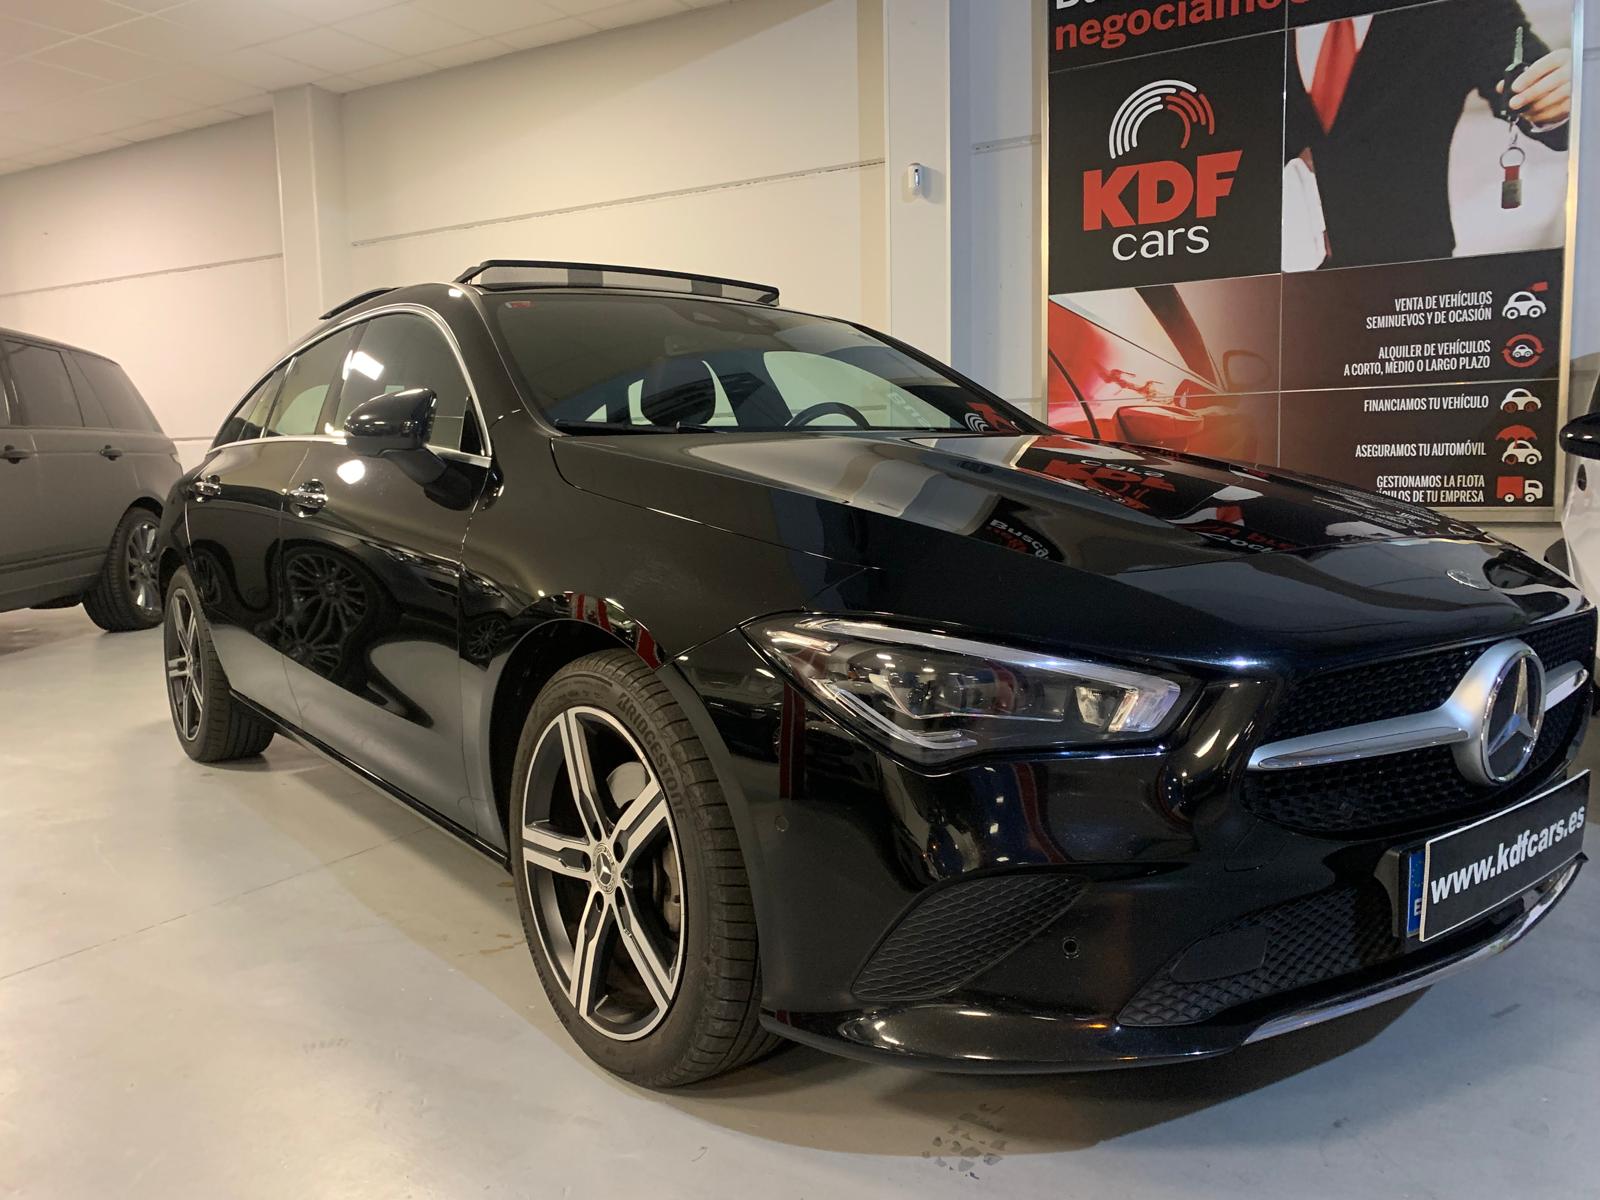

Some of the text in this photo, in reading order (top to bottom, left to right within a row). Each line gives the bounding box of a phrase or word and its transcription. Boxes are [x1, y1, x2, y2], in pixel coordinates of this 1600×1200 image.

[1055, 0, 1310, 51] negociam
[1082, 149, 1243, 231] KDF
[1111, 224, 1210, 261] cars
[1395, 290, 1493, 312] VENTA DE VEHÍCULOS
[1366, 306, 1492, 330] SEMINUEVOS Y DE OCASIÓN
[1378, 338, 1491, 361] ALQUILER DE VEHÍCULOS
[1343, 354, 1491, 377] A CORTO, MEDIO O LARGO PLAZO
[1364, 393, 1489, 413] FINANCIAMOS TU VEHÍCULO
[1355, 439, 1487, 458] ASEGURAMOS TU AUTOMÓVIL
[1376, 475, 1485, 488] GESTIONAMOS LA FLOTA
[1412, 490, 1425, 503] DE
[1426, 490, 1438, 502] TU
[1439, 490, 1484, 503] EMPRESA
[615, 692, 688, 820] BRIDGESTONE
[1430, 805, 1585, 904] www.kdfcars.es
